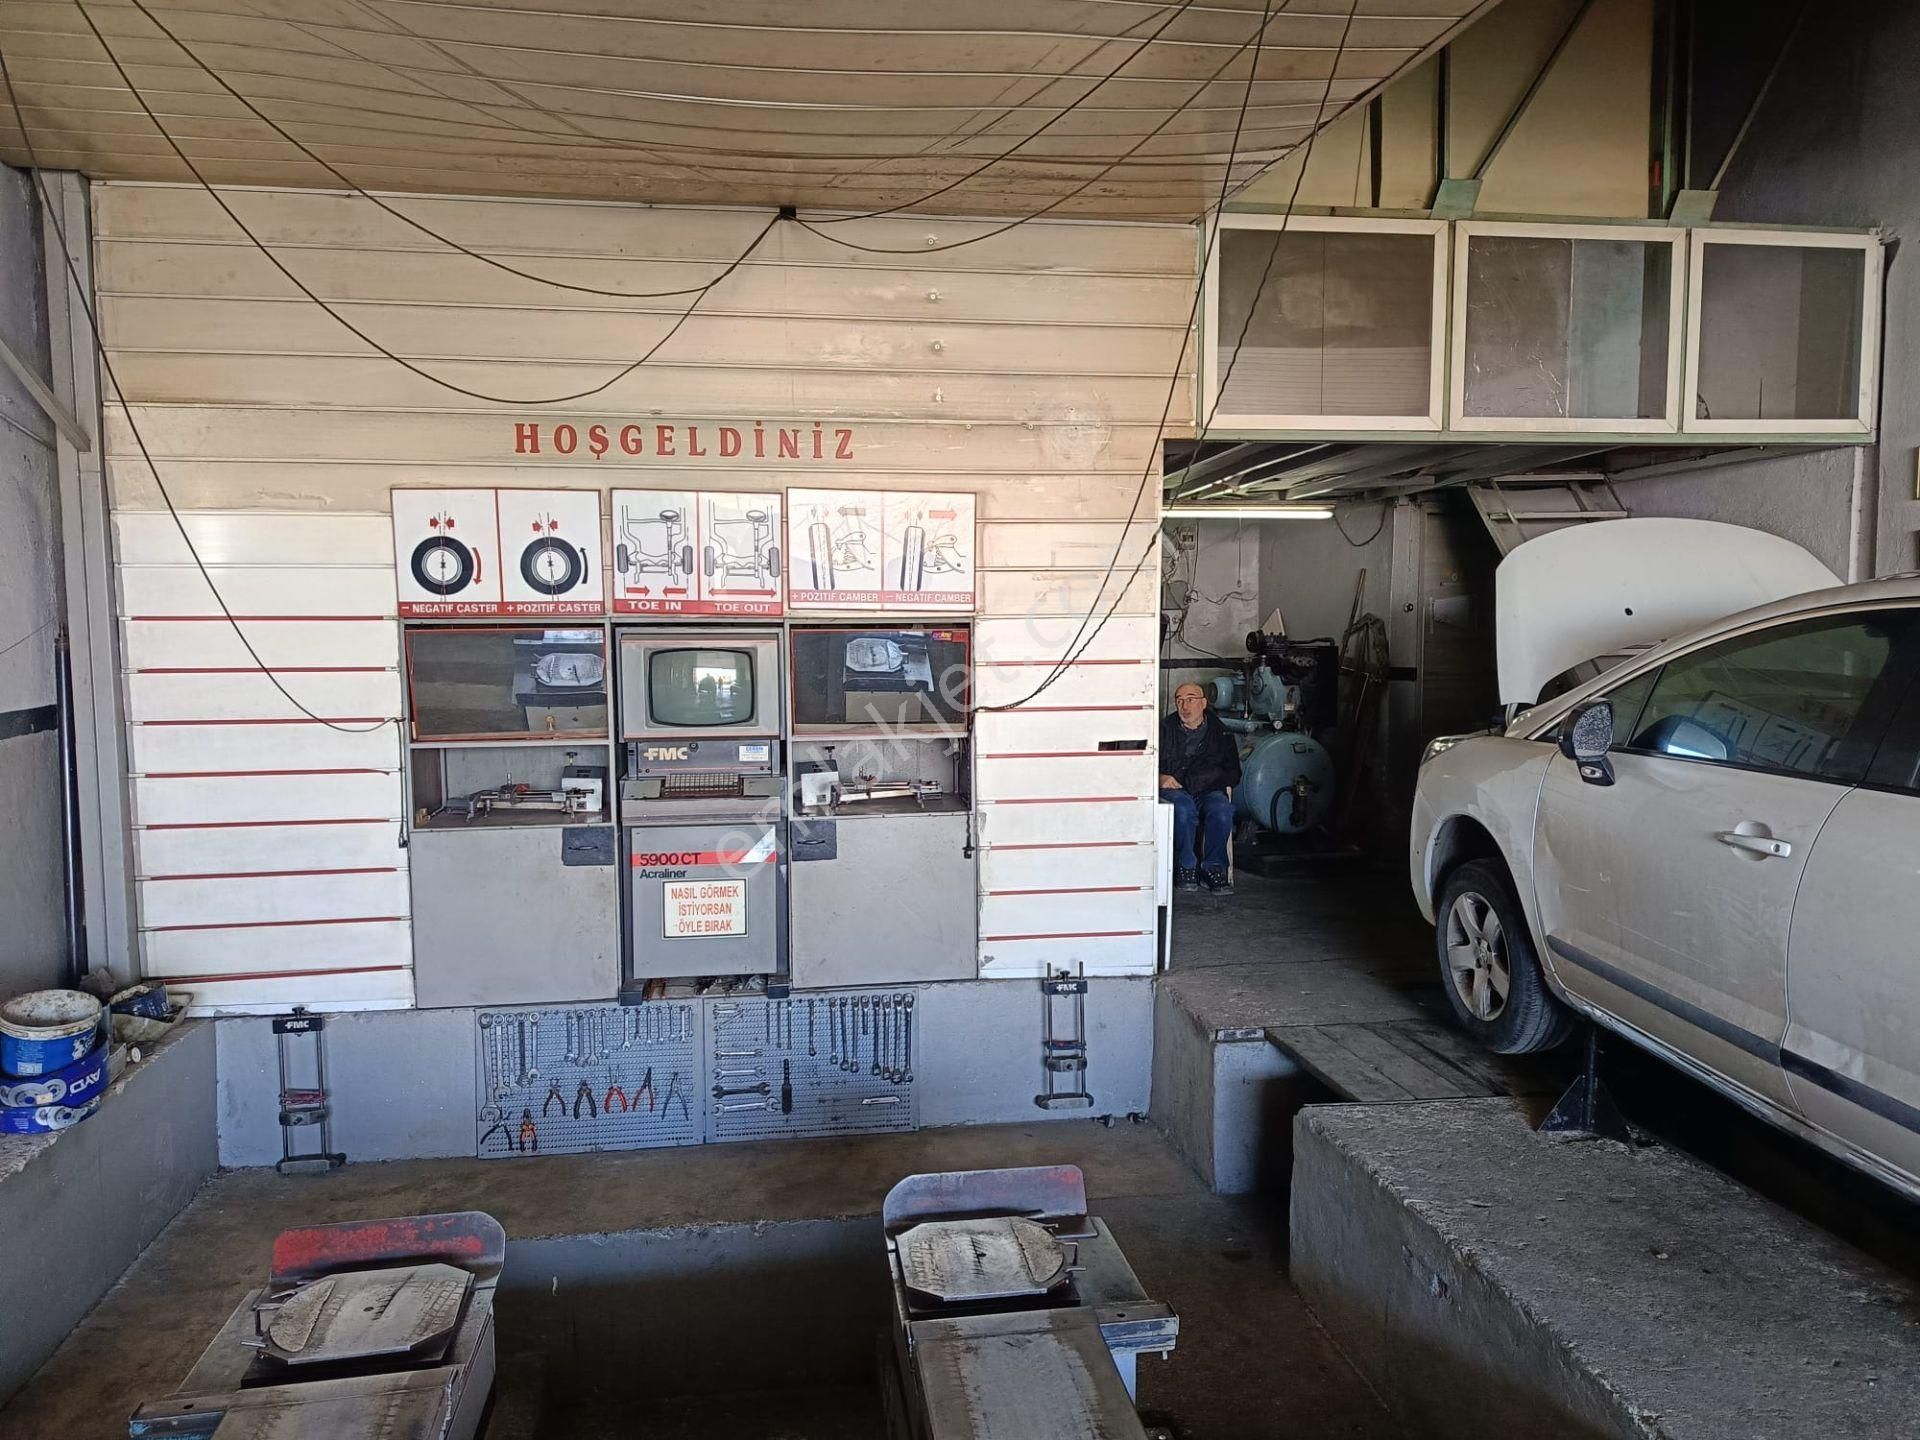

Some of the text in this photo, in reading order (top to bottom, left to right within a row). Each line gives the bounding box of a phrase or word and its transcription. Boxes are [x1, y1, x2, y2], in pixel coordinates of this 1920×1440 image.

[514, 420, 853, 460] HOŞGELDİNİZ
[838, 592, 879, 602] CAMBER
[934, 593, 971, 603] CAMBER
[458, 603, 498, 613] CASTER
[558, 603, 601, 613] CASTER
[628, 600, 682, 611] TOE IN
[714, 602, 771, 613] TOE OUT
[643, 747, 688, 761] FMC
[639, 868, 687, 879] Acraliner
[671, 883, 739, 899] NASIL GÖRMEK
[678, 901, 732, 917] İSTİYORSAN
[678, 919, 732, 933] ÖYLE BIRAK
[284, 1020, 310, 1030] FMC
[69, 1068, 101, 1095] AYD
